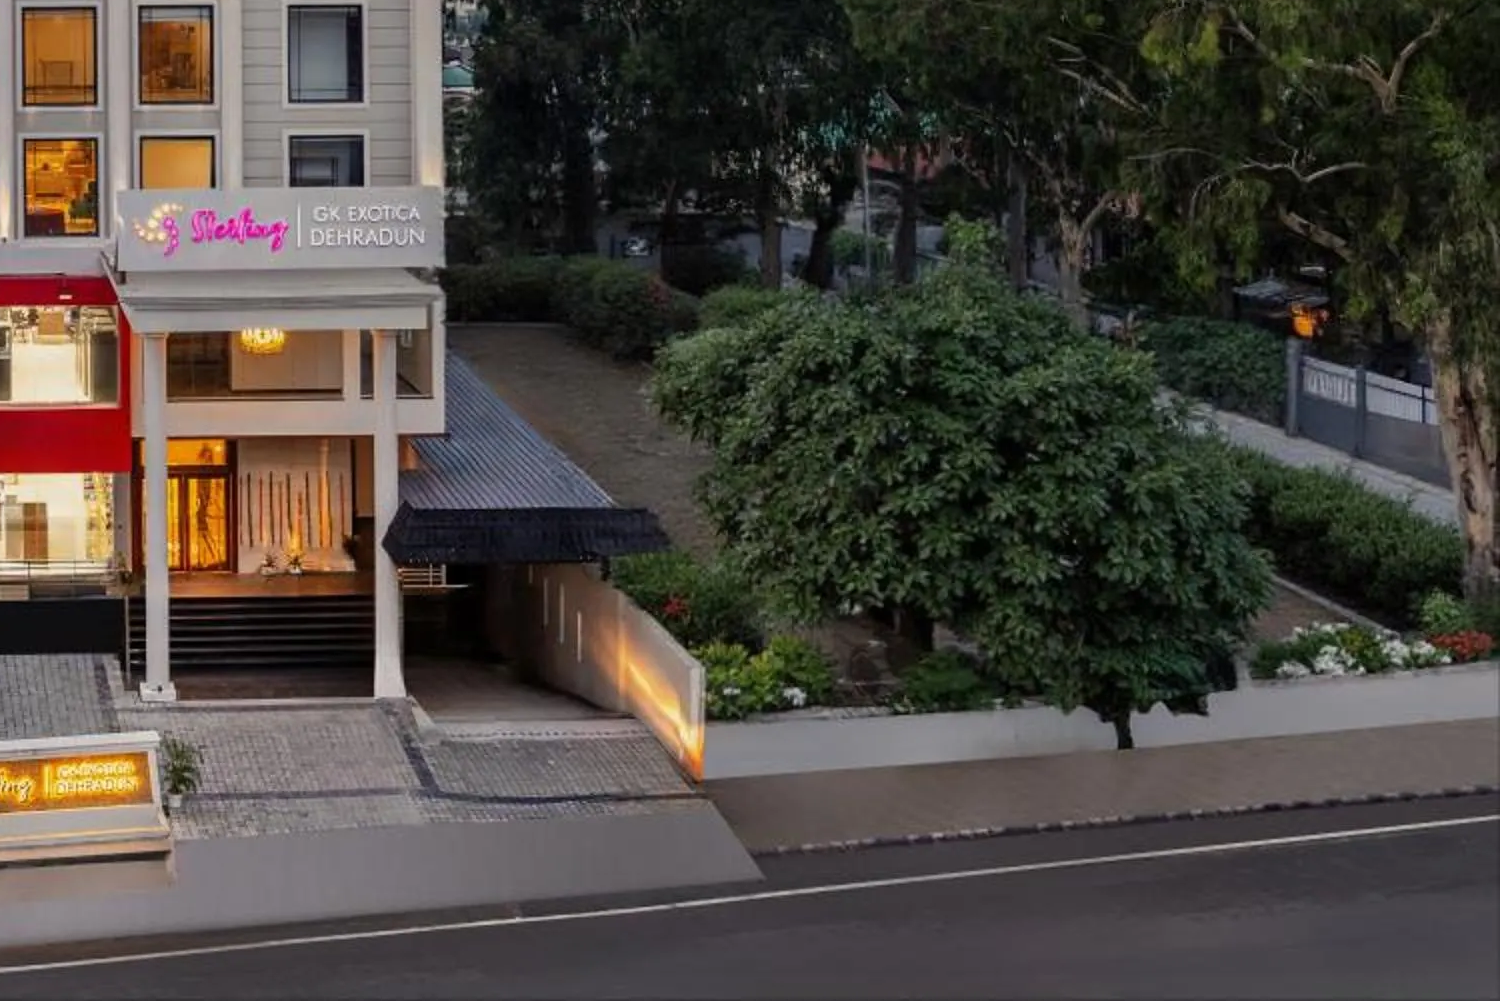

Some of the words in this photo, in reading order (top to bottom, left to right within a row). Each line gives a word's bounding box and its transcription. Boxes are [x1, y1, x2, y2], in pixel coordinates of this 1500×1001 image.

[313, 205, 340, 222] GK
[347, 205, 420, 222] EXOTICA
[191, 207, 289, 253] Sterling
[310, 227, 426, 247] DEHRADUN
